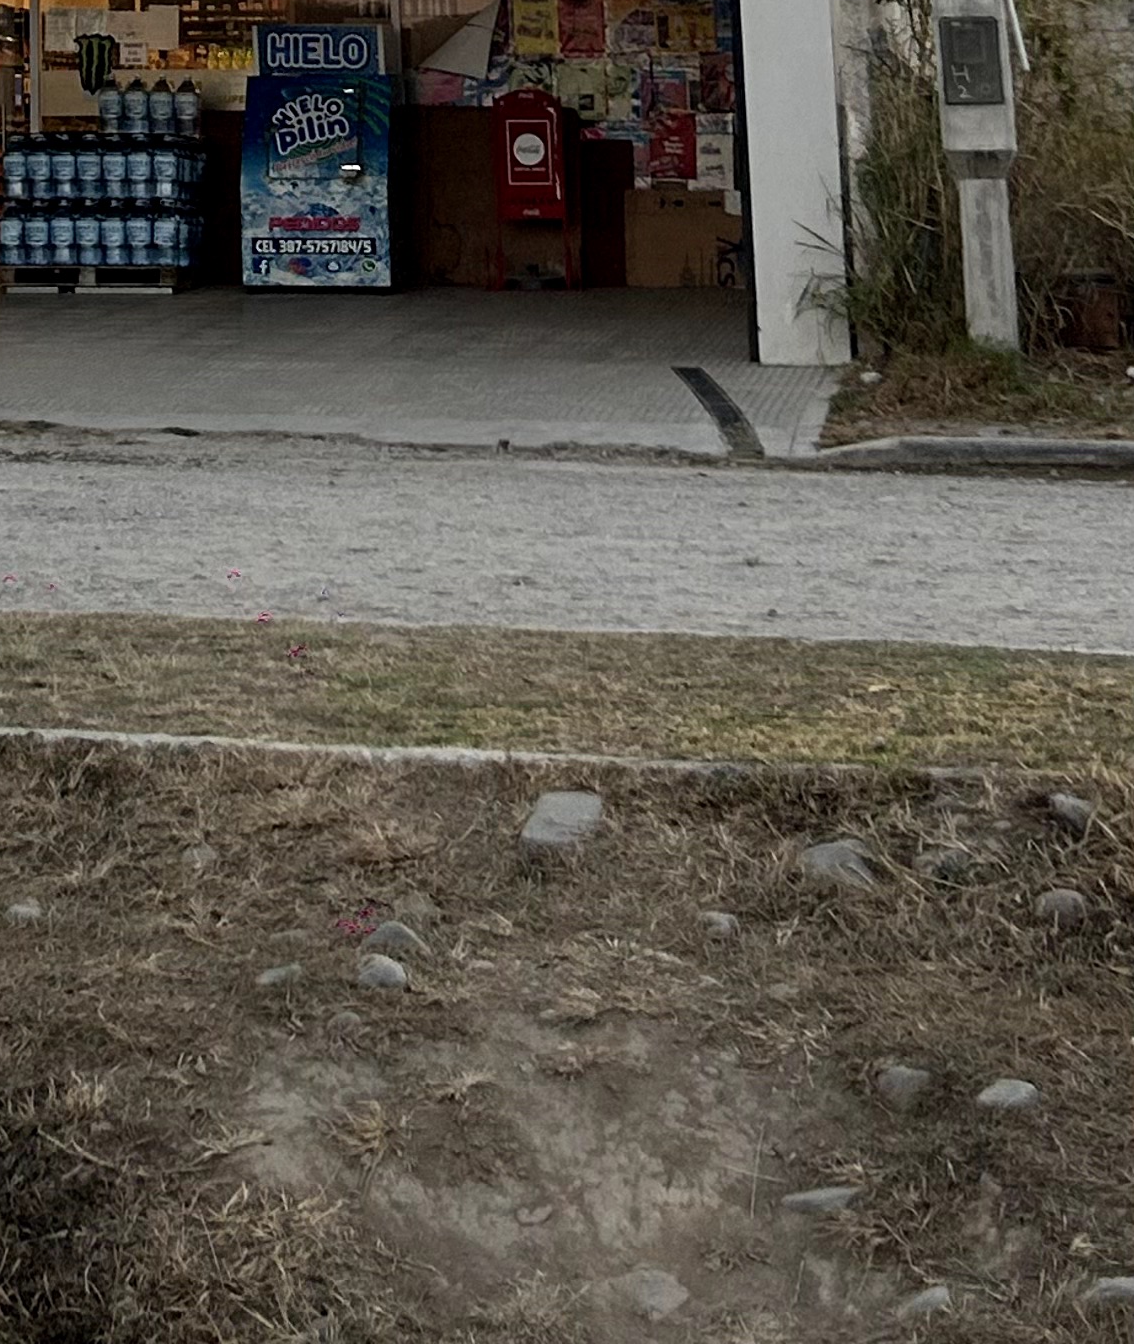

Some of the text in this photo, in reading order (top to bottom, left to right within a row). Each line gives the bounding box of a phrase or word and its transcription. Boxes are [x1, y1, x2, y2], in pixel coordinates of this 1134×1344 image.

[267, 33, 367, 68] HIELO
[272, 94, 344, 129] HIELO
[255, 239, 277, 253] CEL
